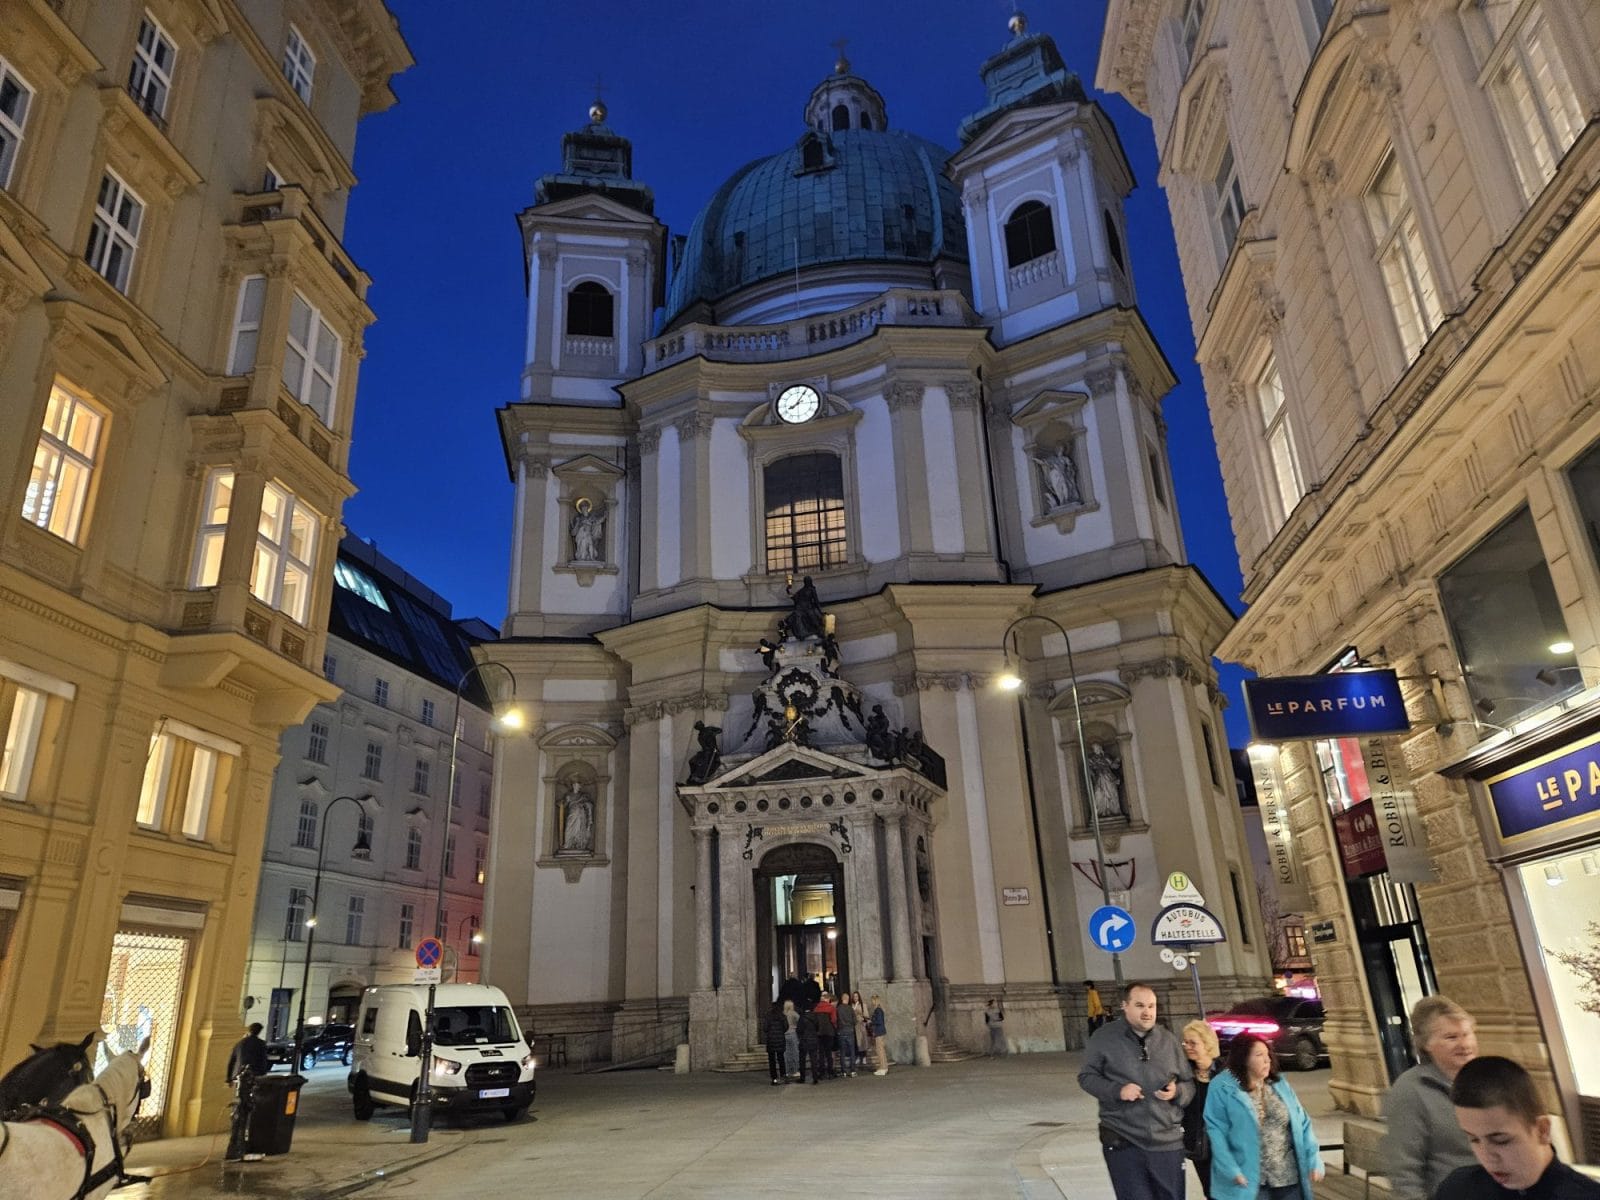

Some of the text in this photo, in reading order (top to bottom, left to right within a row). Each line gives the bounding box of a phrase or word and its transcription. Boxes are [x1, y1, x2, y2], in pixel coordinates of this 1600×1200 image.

[1267, 695, 1386, 714] LE PARFUM
[1377, 774, 1391, 785] &
[1536, 776, 1560, 801] LE
[1260, 768, 1292, 885] ROBBE & BERKING
[1381, 789, 1406, 848] ROBBE
[1173, 875, 1185, 888] H
[1165, 909, 1208, 923] AUTOBUS
[1160, 929, 1216, 939] HALTESTELLE
